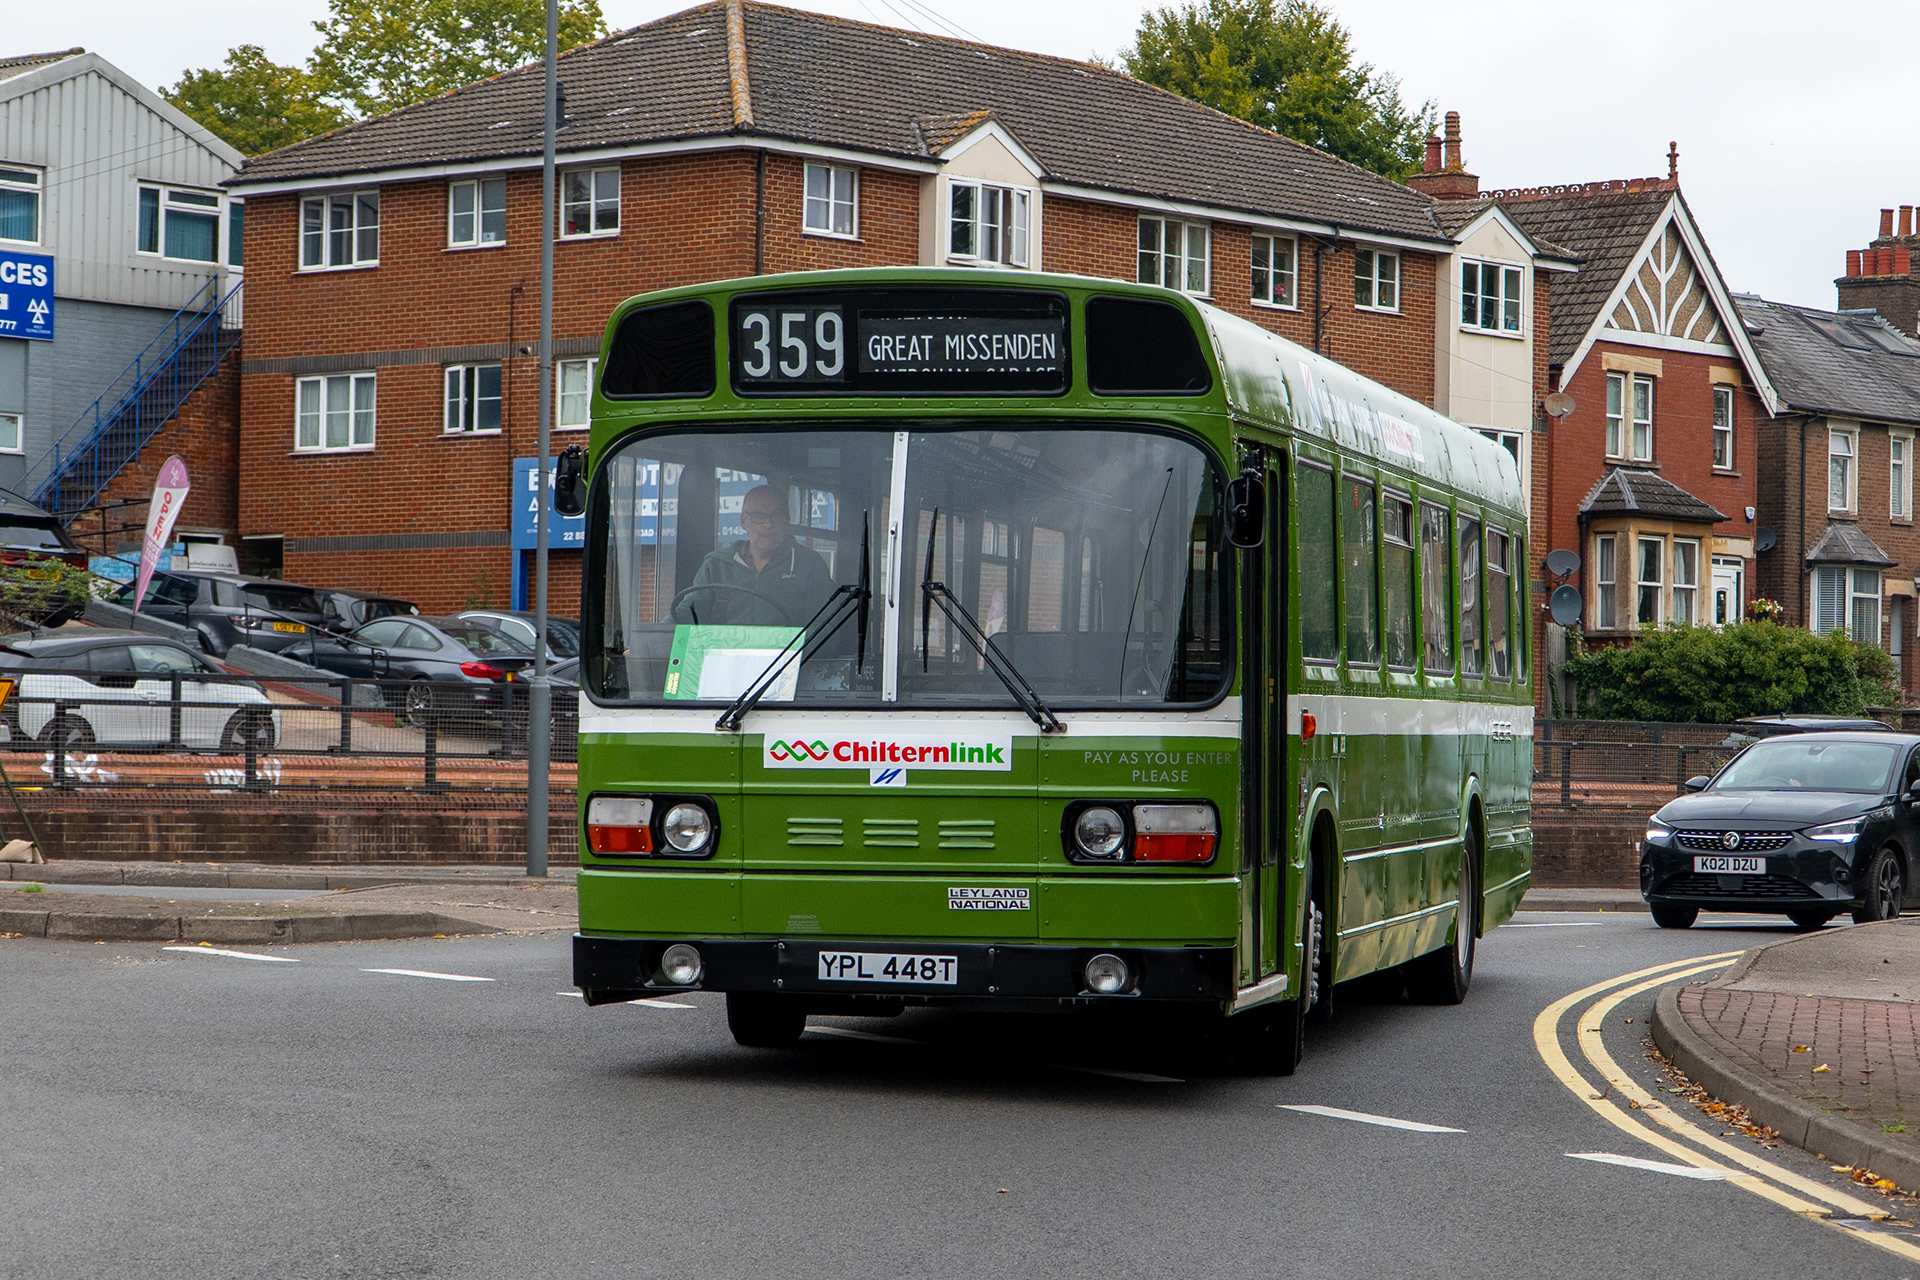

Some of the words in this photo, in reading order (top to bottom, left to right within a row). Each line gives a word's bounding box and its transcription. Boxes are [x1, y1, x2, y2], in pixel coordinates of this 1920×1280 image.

[742, 311, 845, 378] 359
[868, 335, 933, 361] GREAT
[945, 334, 1056, 360] MISSENDEN
[153, 491, 172, 541] OPEN
[833, 740, 1005, 764] Chilternlink
[1084, 752, 1113, 764] PAY
[1118, 752, 1139, 764] AS
[1145, 752, 1180, 765] YOU
[1186, 752, 1232, 765] ENTER
[1132, 769, 1189, 782] PLEASE
[1701, 857, 1729, 871] KO21
[1732, 858, 1758, 871] DZU
[949, 888, 1028, 898] LEYLAND
[950, 899, 1029, 909] NATIONAL
[820, 954, 874, 979] YPL
[882, 956, 956, 982] 448T
